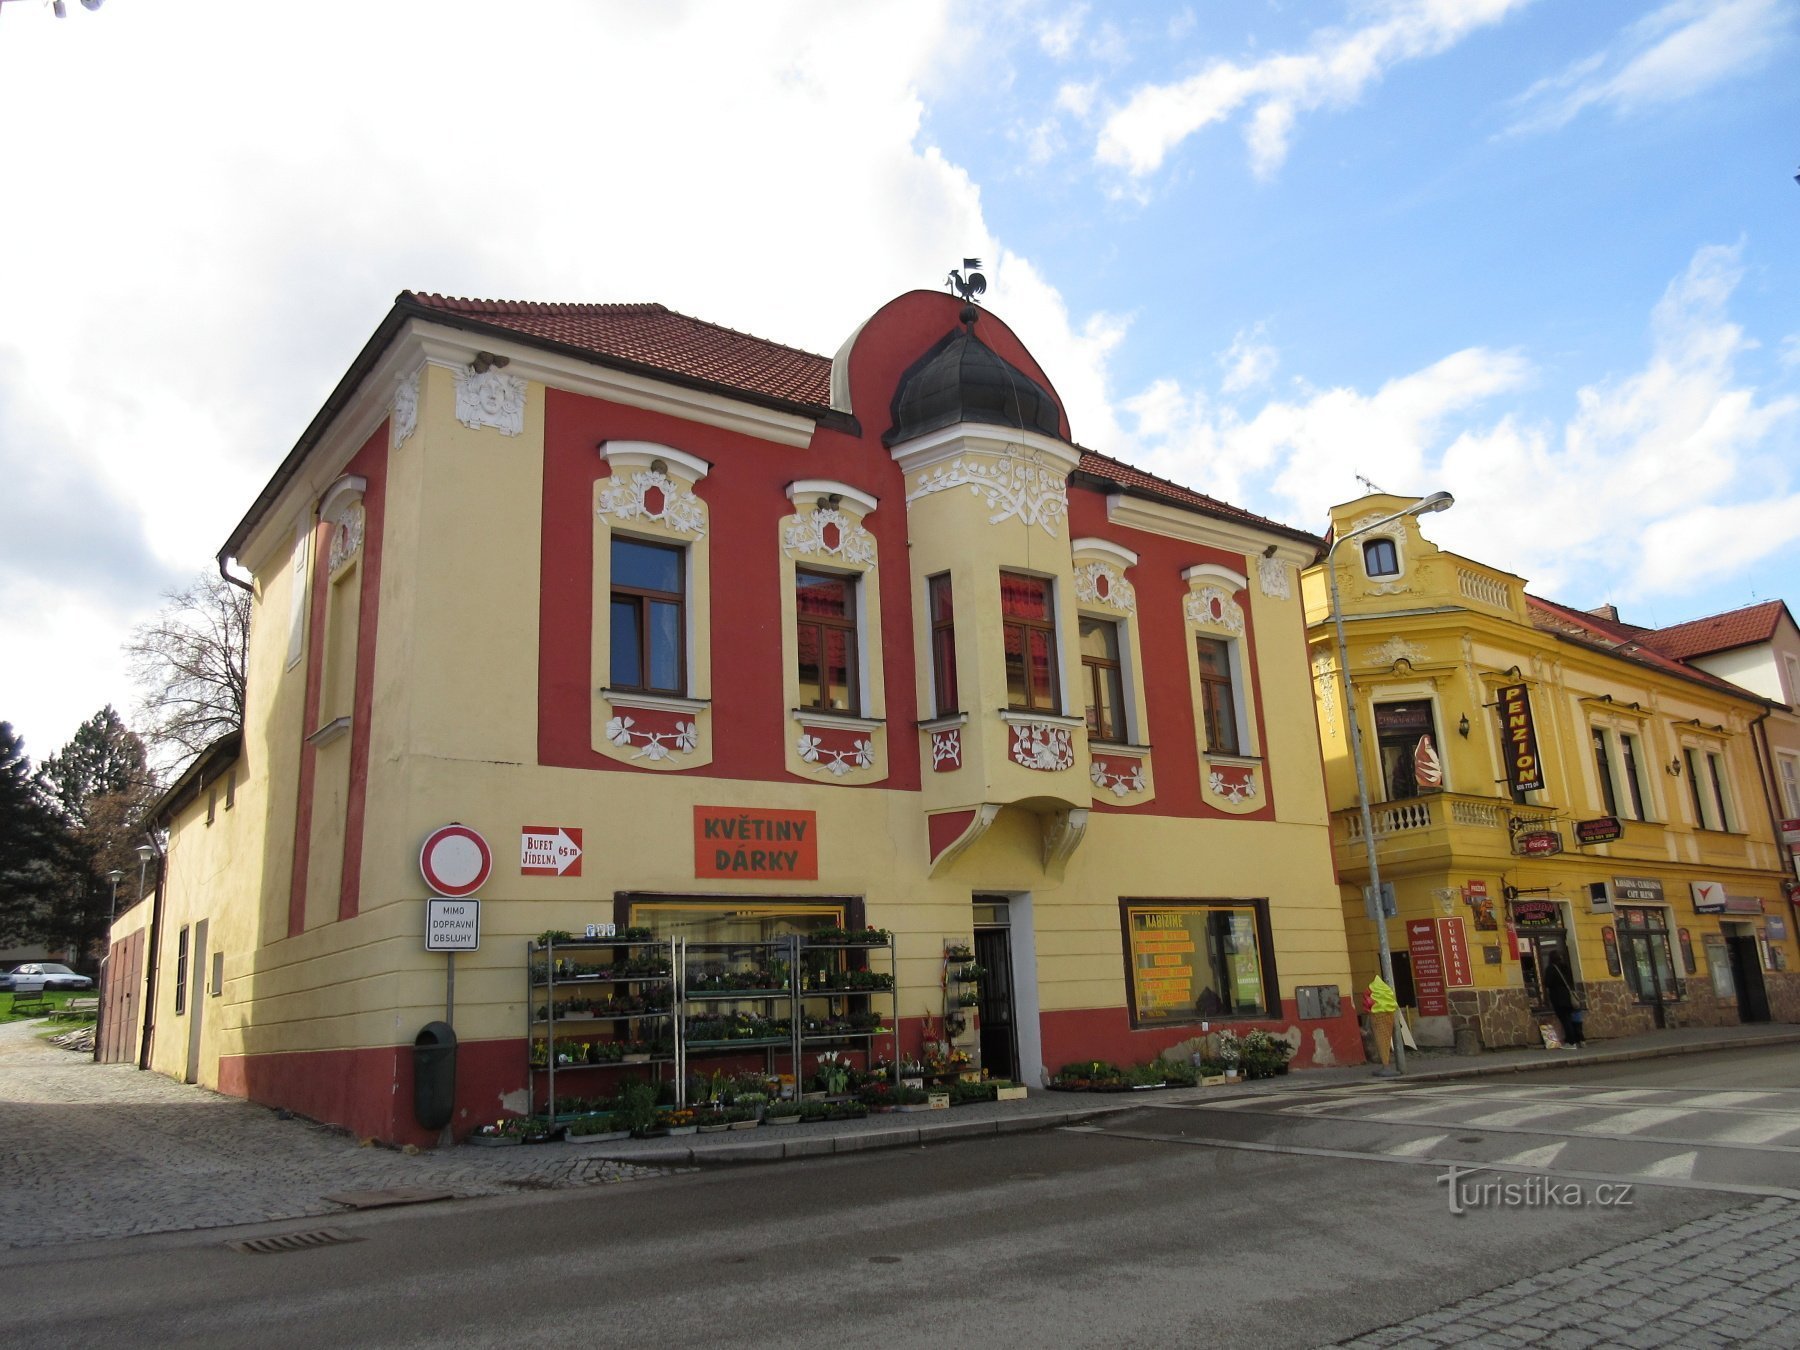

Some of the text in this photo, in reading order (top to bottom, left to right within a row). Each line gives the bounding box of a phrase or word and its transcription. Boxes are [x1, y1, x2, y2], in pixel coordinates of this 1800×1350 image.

[1506, 688, 1534, 782] PENZION
[704, 814, 807, 842] KVĚTINY
[527, 836, 553, 850] BUFET
[522, 851, 557, 865] JÍDELNA
[558, 846, 578, 857] 65 m
[715, 843, 798, 872] DÁRKY
[443, 906, 465, 915] MIMO
[433, 919, 474, 929] DOPRAVNÍ
[433, 934, 472, 942] OBSLUHY
